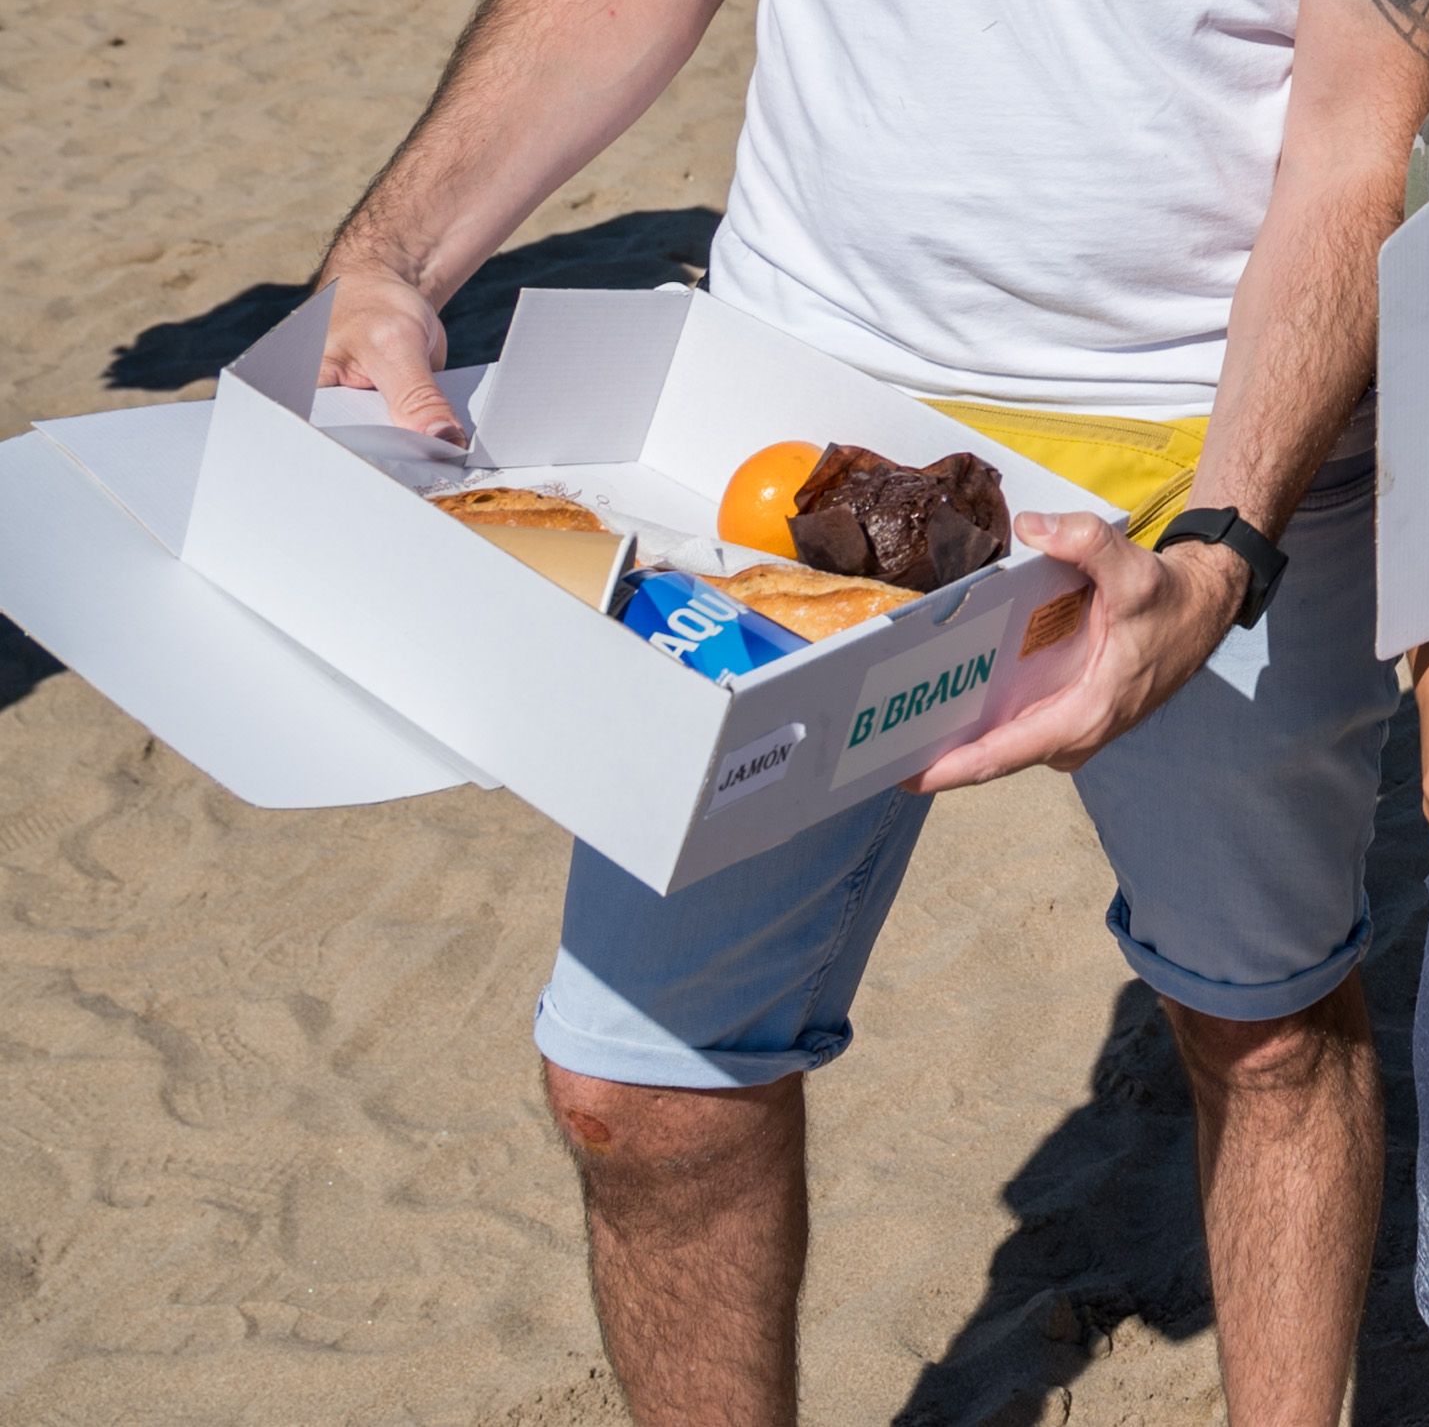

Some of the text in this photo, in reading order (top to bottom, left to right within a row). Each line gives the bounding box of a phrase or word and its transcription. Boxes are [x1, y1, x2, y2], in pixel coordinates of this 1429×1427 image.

[848, 648, 997, 749] B BRAUN
[718, 742, 793, 791] JAMÓN
